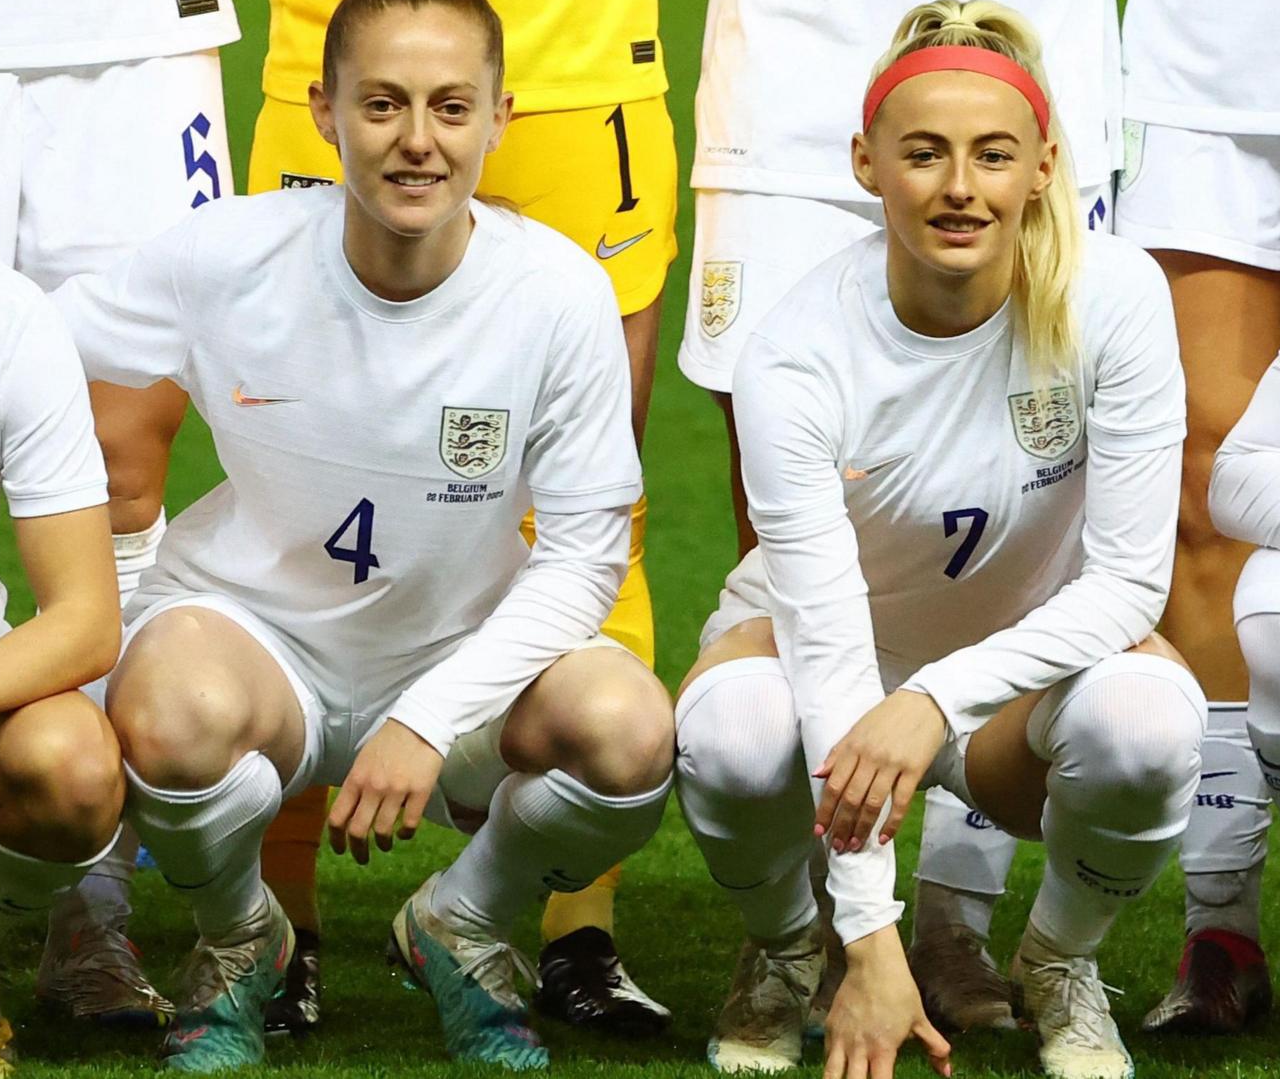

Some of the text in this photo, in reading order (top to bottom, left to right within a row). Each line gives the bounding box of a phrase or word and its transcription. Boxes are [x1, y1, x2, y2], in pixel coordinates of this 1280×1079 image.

[605, 104, 640, 213] 1
[1030, 468, 1072, 491] FEBRUARY
[1036, 459, 1074, 478] BELGIUM
[426, 493, 437, 501] 22
[438, 494, 485, 503] FEBRUARY
[447, 484, 487, 493] BELGIUM
[323, 497, 381, 585] 4
[942, 507, 989, 580] 7
